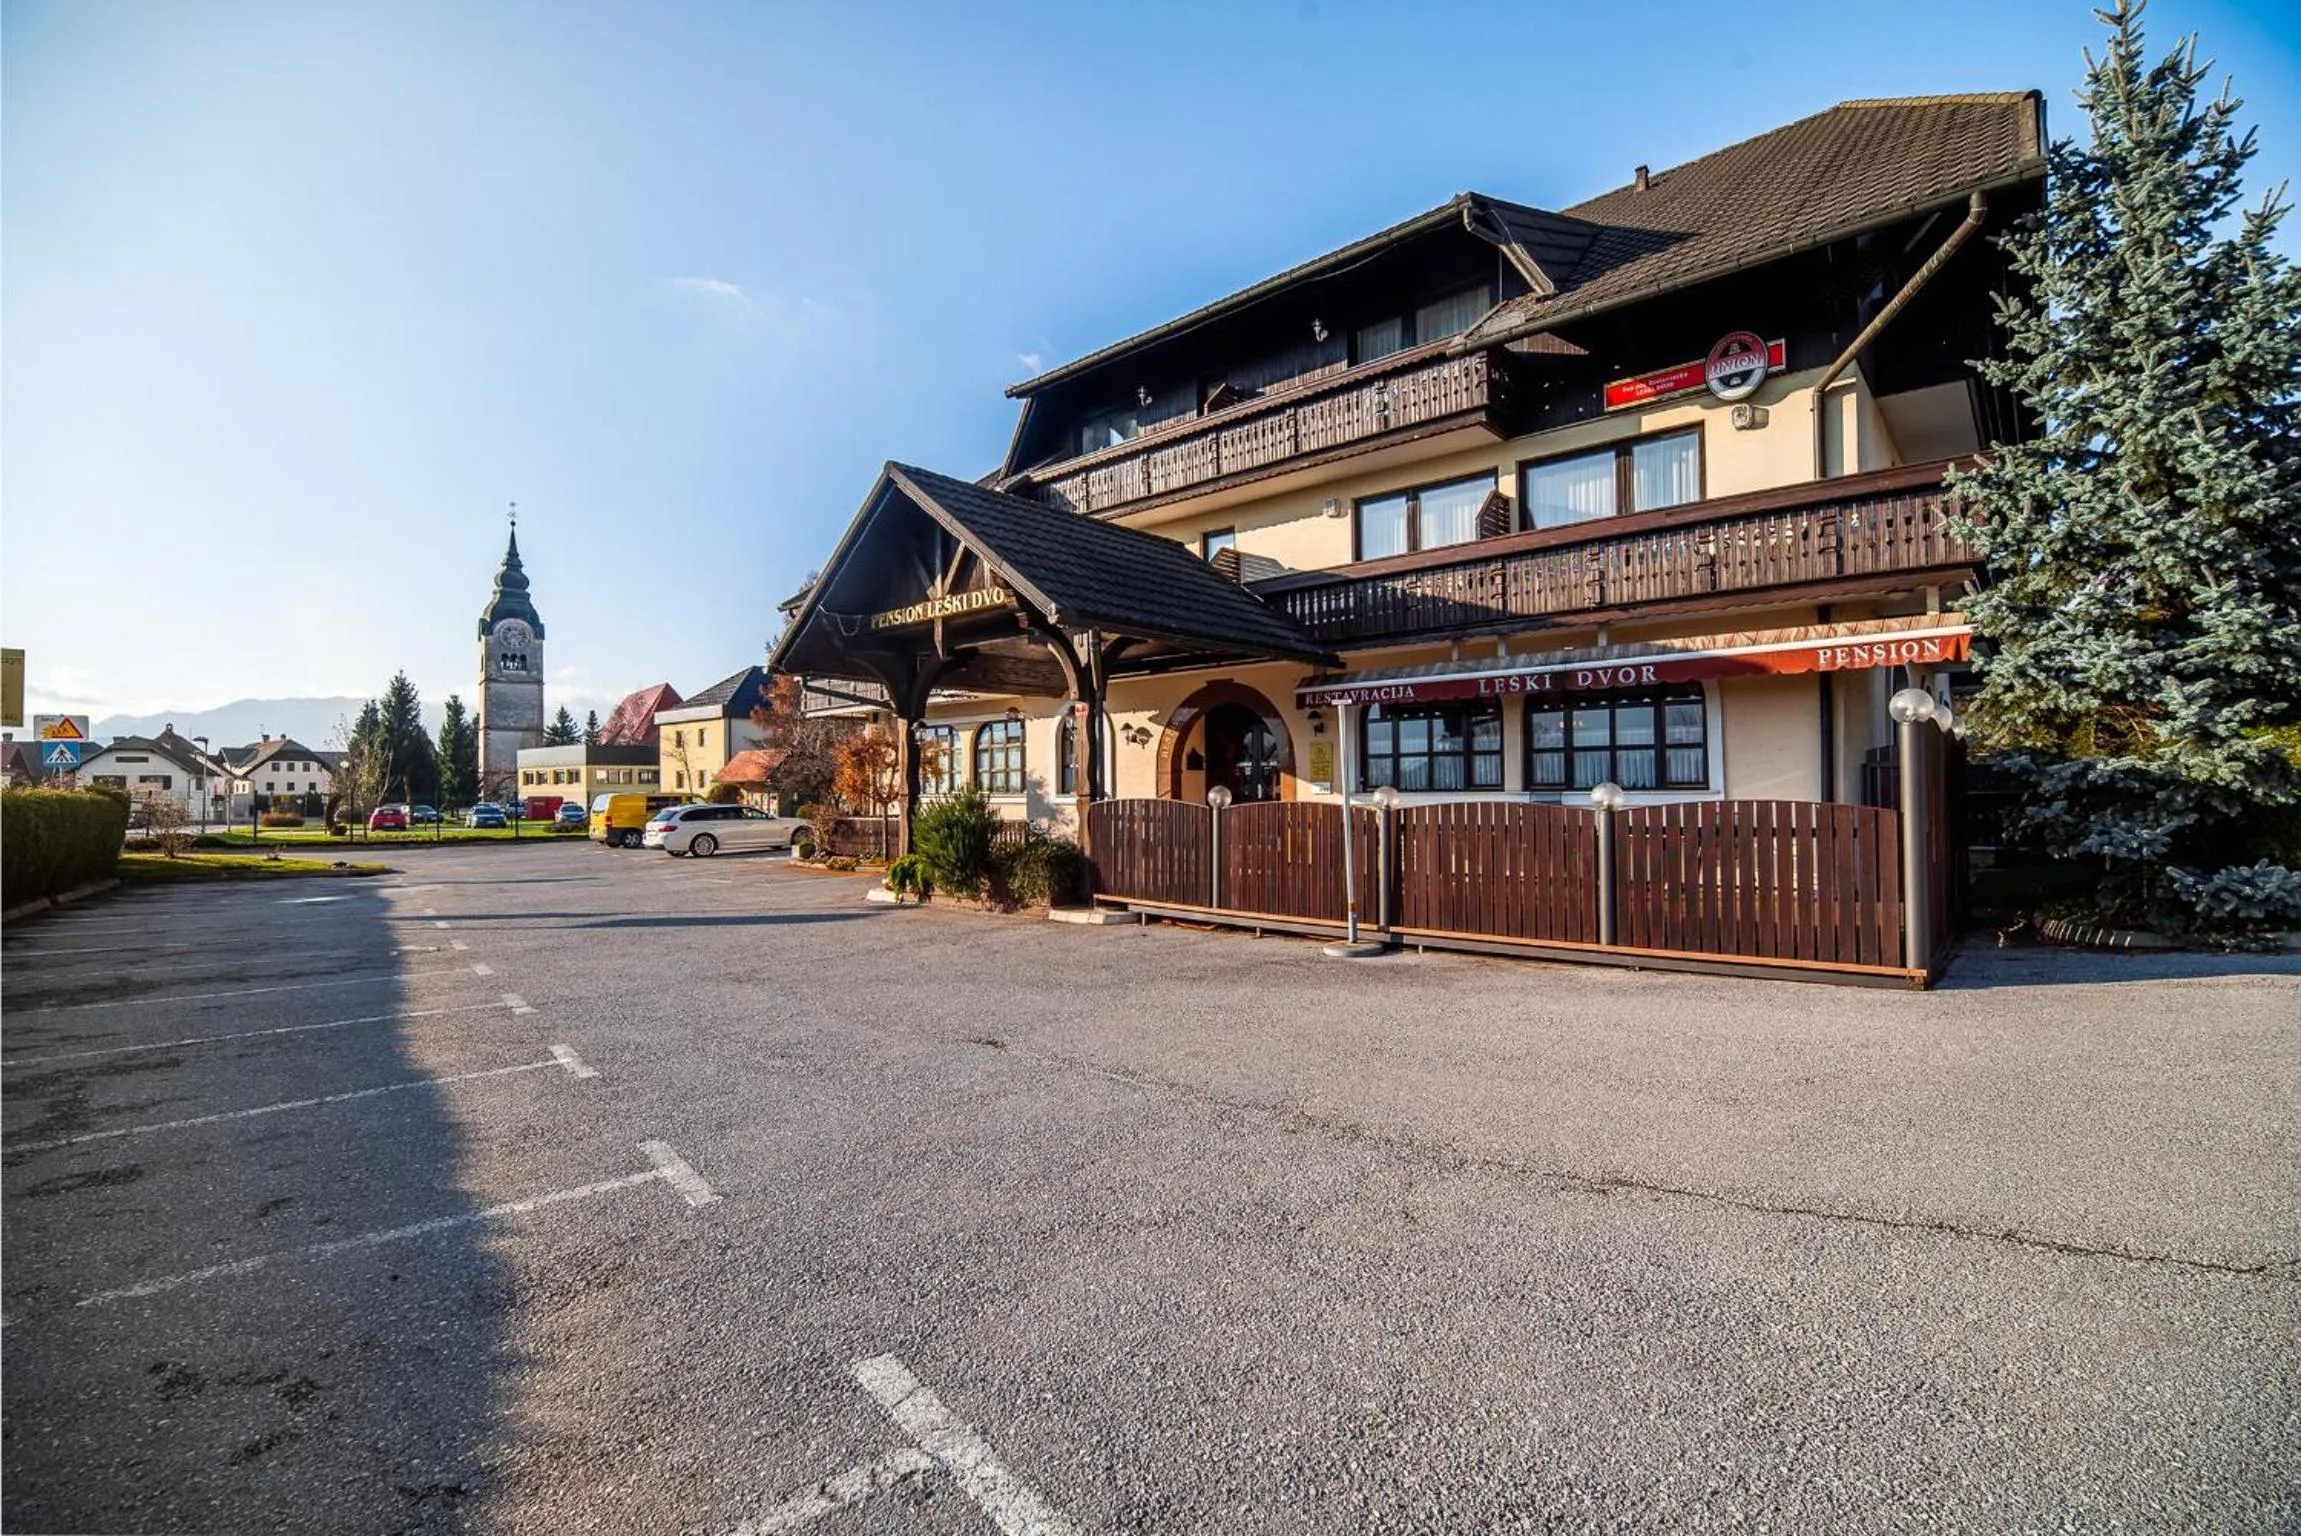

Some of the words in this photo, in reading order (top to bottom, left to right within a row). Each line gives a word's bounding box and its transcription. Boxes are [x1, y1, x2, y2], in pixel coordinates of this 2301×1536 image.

[1711, 353, 1763, 375] UNION
[927, 593, 967, 617] LEŠKI
[971, 586, 1009, 608] DVO
[1305, 685, 1414, 705] RESTAVRACIJA
[1577, 665, 1657, 687] DVOR
[1817, 639, 1942, 663] PENSION
